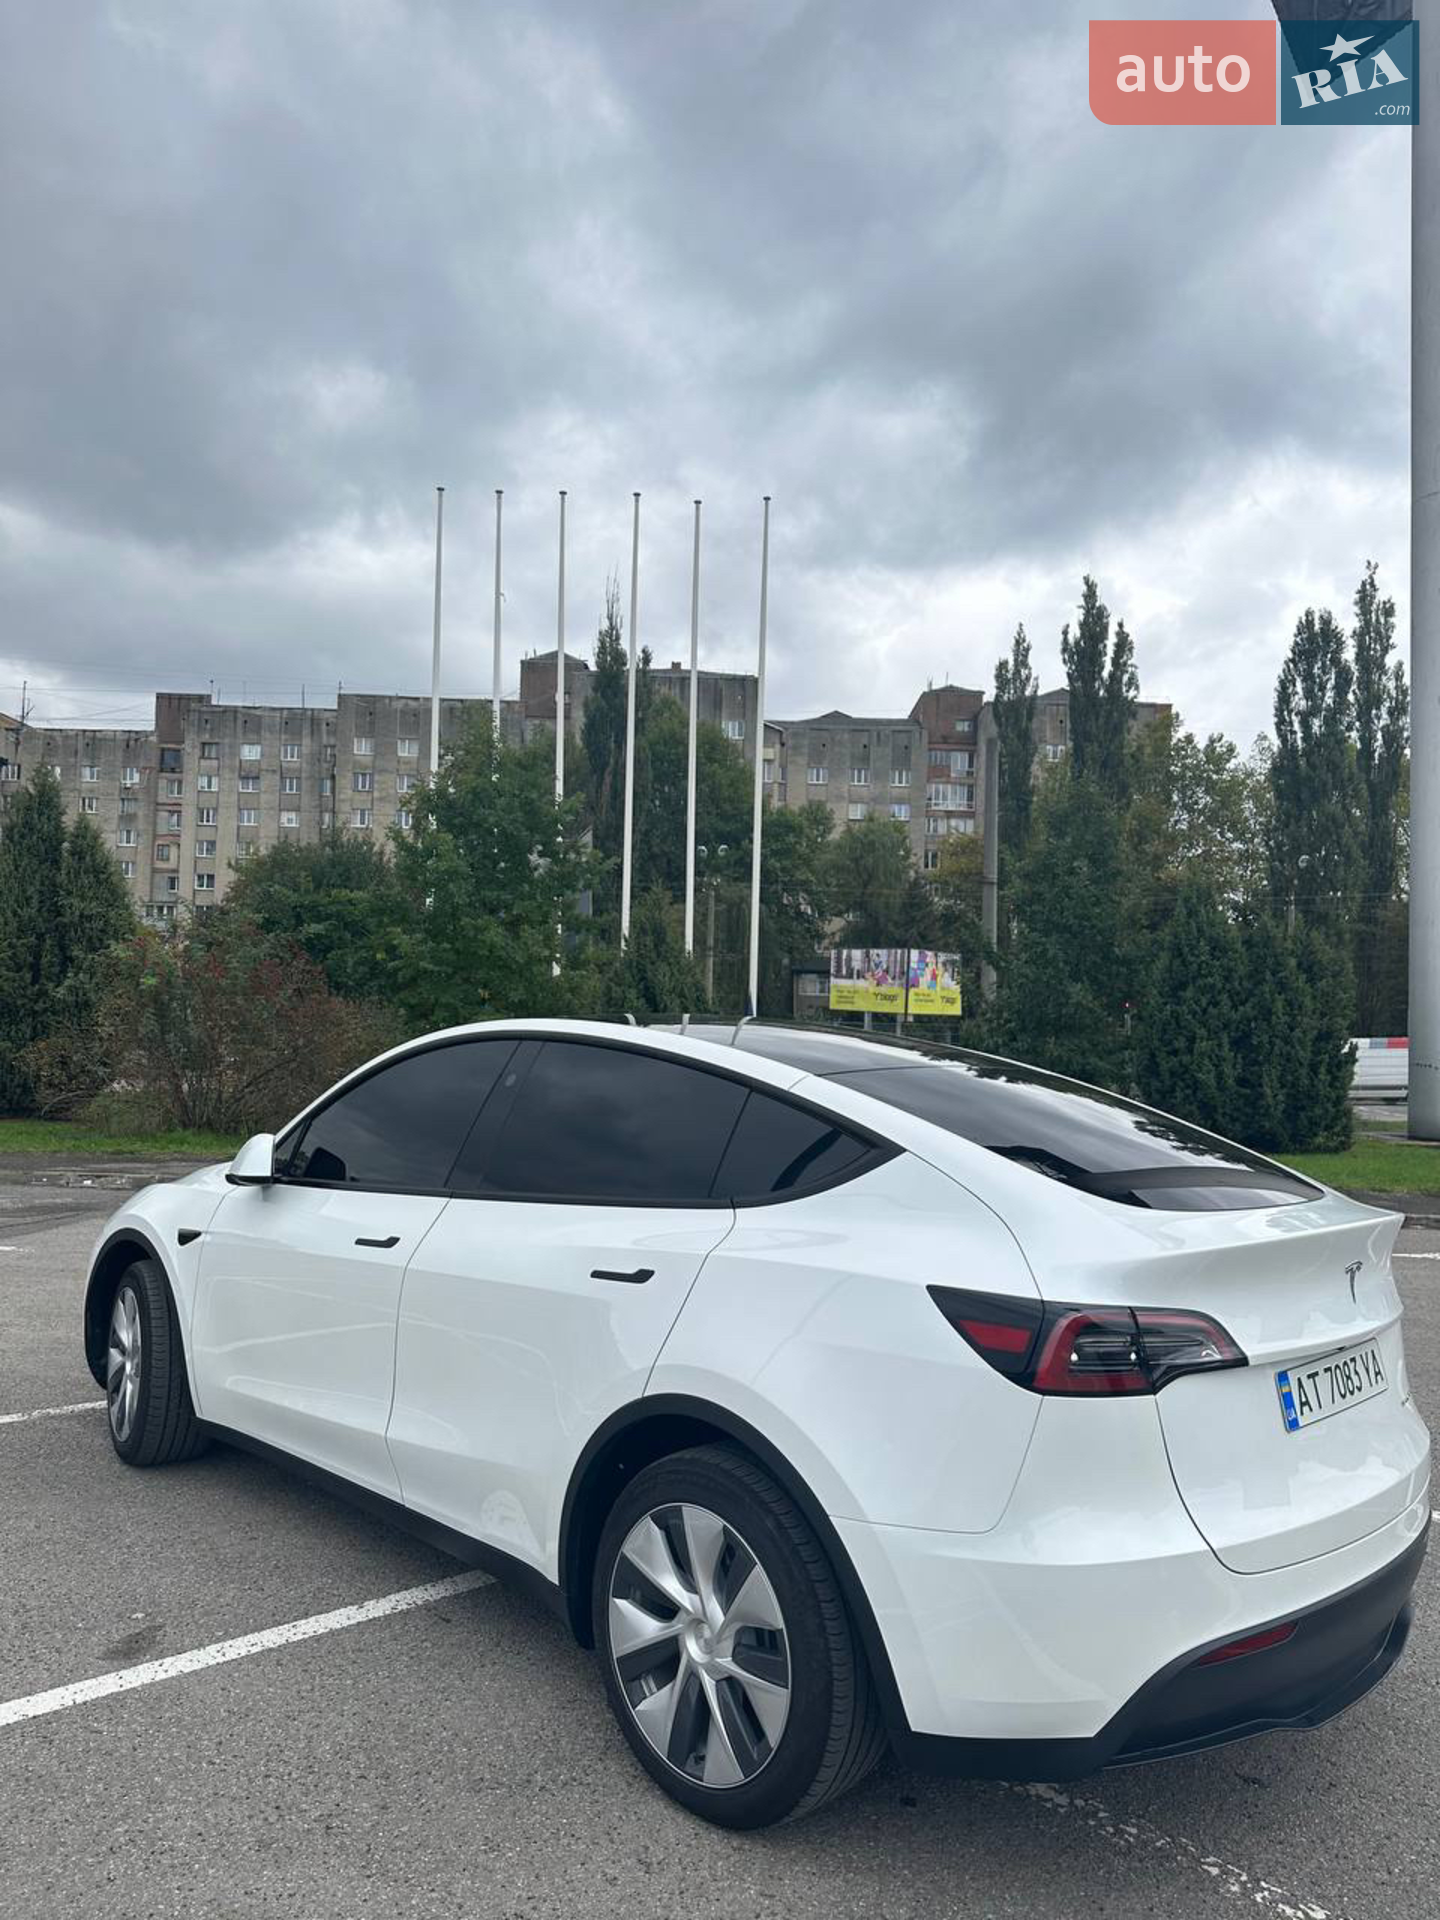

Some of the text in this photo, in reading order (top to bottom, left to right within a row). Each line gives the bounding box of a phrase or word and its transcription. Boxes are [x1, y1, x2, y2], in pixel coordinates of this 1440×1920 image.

[1296, 1349, 1384, 1416] AT 7083 YA
